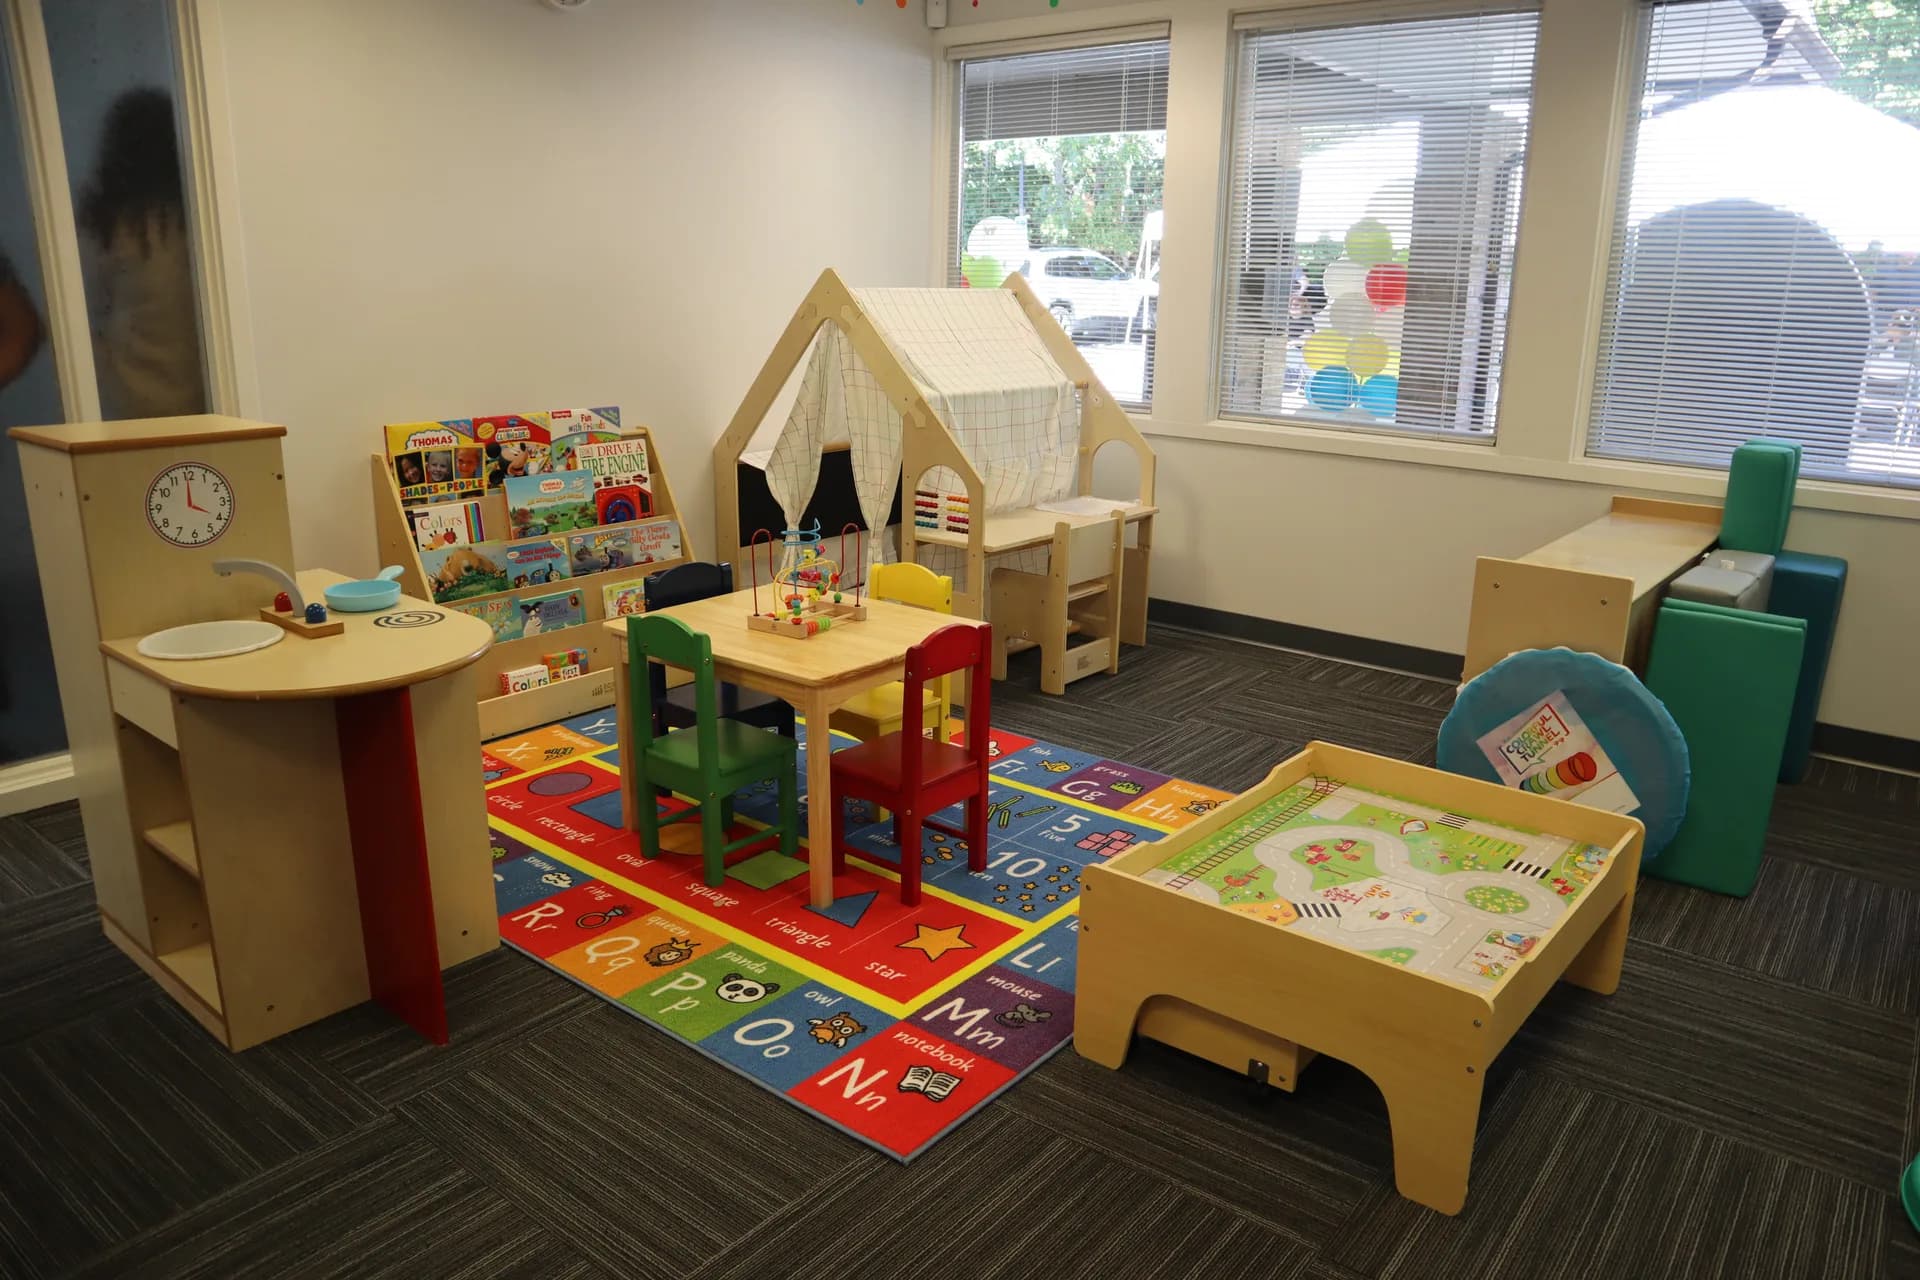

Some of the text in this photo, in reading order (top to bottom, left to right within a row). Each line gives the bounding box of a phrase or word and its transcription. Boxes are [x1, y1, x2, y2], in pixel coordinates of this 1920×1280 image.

[581, 414, 592, 422] Fun
[569, 423, 582, 432] with
[412, 435, 453, 447] THOMAS
[597, 441, 644, 456] DRIVE A
[581, 453, 646, 477] FIRE ENGINE
[170, 476, 178, 487] 11
[182, 470, 195, 481] 12
[203, 474, 206, 483] 1
[159, 487, 171, 498] 10
[212, 482, 219, 493] 2
[400, 484, 439, 499] SHADES
[447, 479, 484, 493] PEOPLE
[155, 503, 162, 514] 9
[219, 496, 226, 507] 3
[162, 518, 169, 528] 8
[216, 512, 222, 521] 4
[420, 514, 462, 530] Colors
[176, 526, 183, 536] 7
[191, 528, 198, 538] 6
[207, 522, 214, 533] 5
[562, 666, 577, 675] first
[512, 677, 548, 693] Colors
[1506, 714, 1553, 754] COLORFUL
[1516, 726, 1552, 755] CRAWL
[1520, 730, 1560, 762] TUNNEL
[1093, 766, 1129, 778] grass
[1061, 780, 1107, 801] Gg
[488, 794, 523, 811] circle
[1131, 798, 1180, 822] Hh
[535, 816, 595, 844] rectangle
[1051, 814, 1091, 833] 5
[1037, 829, 1066, 842] five
[523, 856, 557, 871] snow
[616, 853, 655, 869] oval
[986, 851, 1047, 878] 10
[583, 884, 614, 902] ring
[685, 881, 739, 907] square
[511, 902, 565, 932] Rr
[648, 913, 689, 938] queen
[765, 915, 833, 951] triangle
[585, 936, 641, 975] Qq
[716, 949, 769, 975] panda
[864, 958, 907, 982] star
[649, 971, 707, 1014] Pp
[985, 973, 1043, 1002] mouse
[804, 986, 845, 1008] owl
[921, 996, 1007, 1050] Mm
[733, 1017, 796, 1059] Oo
[893, 1029, 976, 1073] notebook
[817, 1057, 889, 1112] Nn
